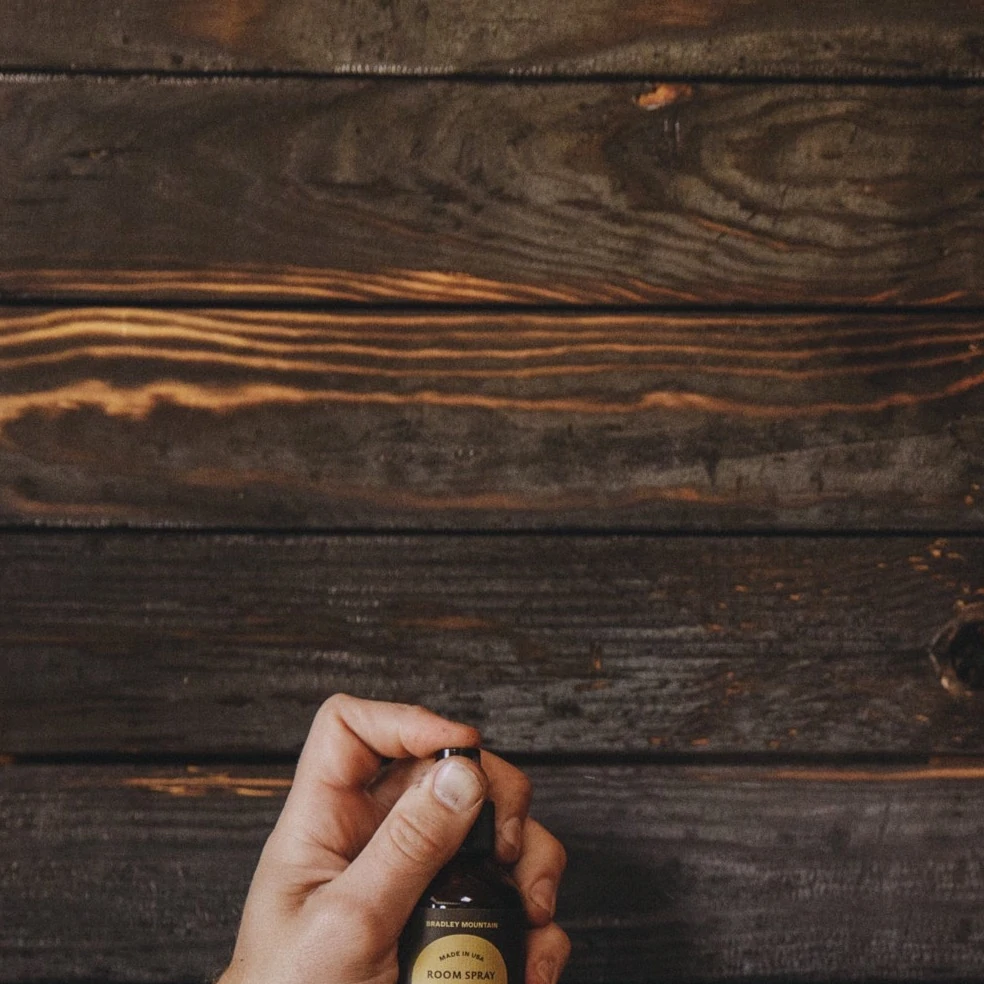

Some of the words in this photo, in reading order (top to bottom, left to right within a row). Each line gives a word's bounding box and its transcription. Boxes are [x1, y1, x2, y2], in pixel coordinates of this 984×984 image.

[439, 951, 460, 961] MADE
[471, 953, 485, 962] USA
[427, 971, 461, 979] ROOM
[465, 971, 495, 980] SPRAY
